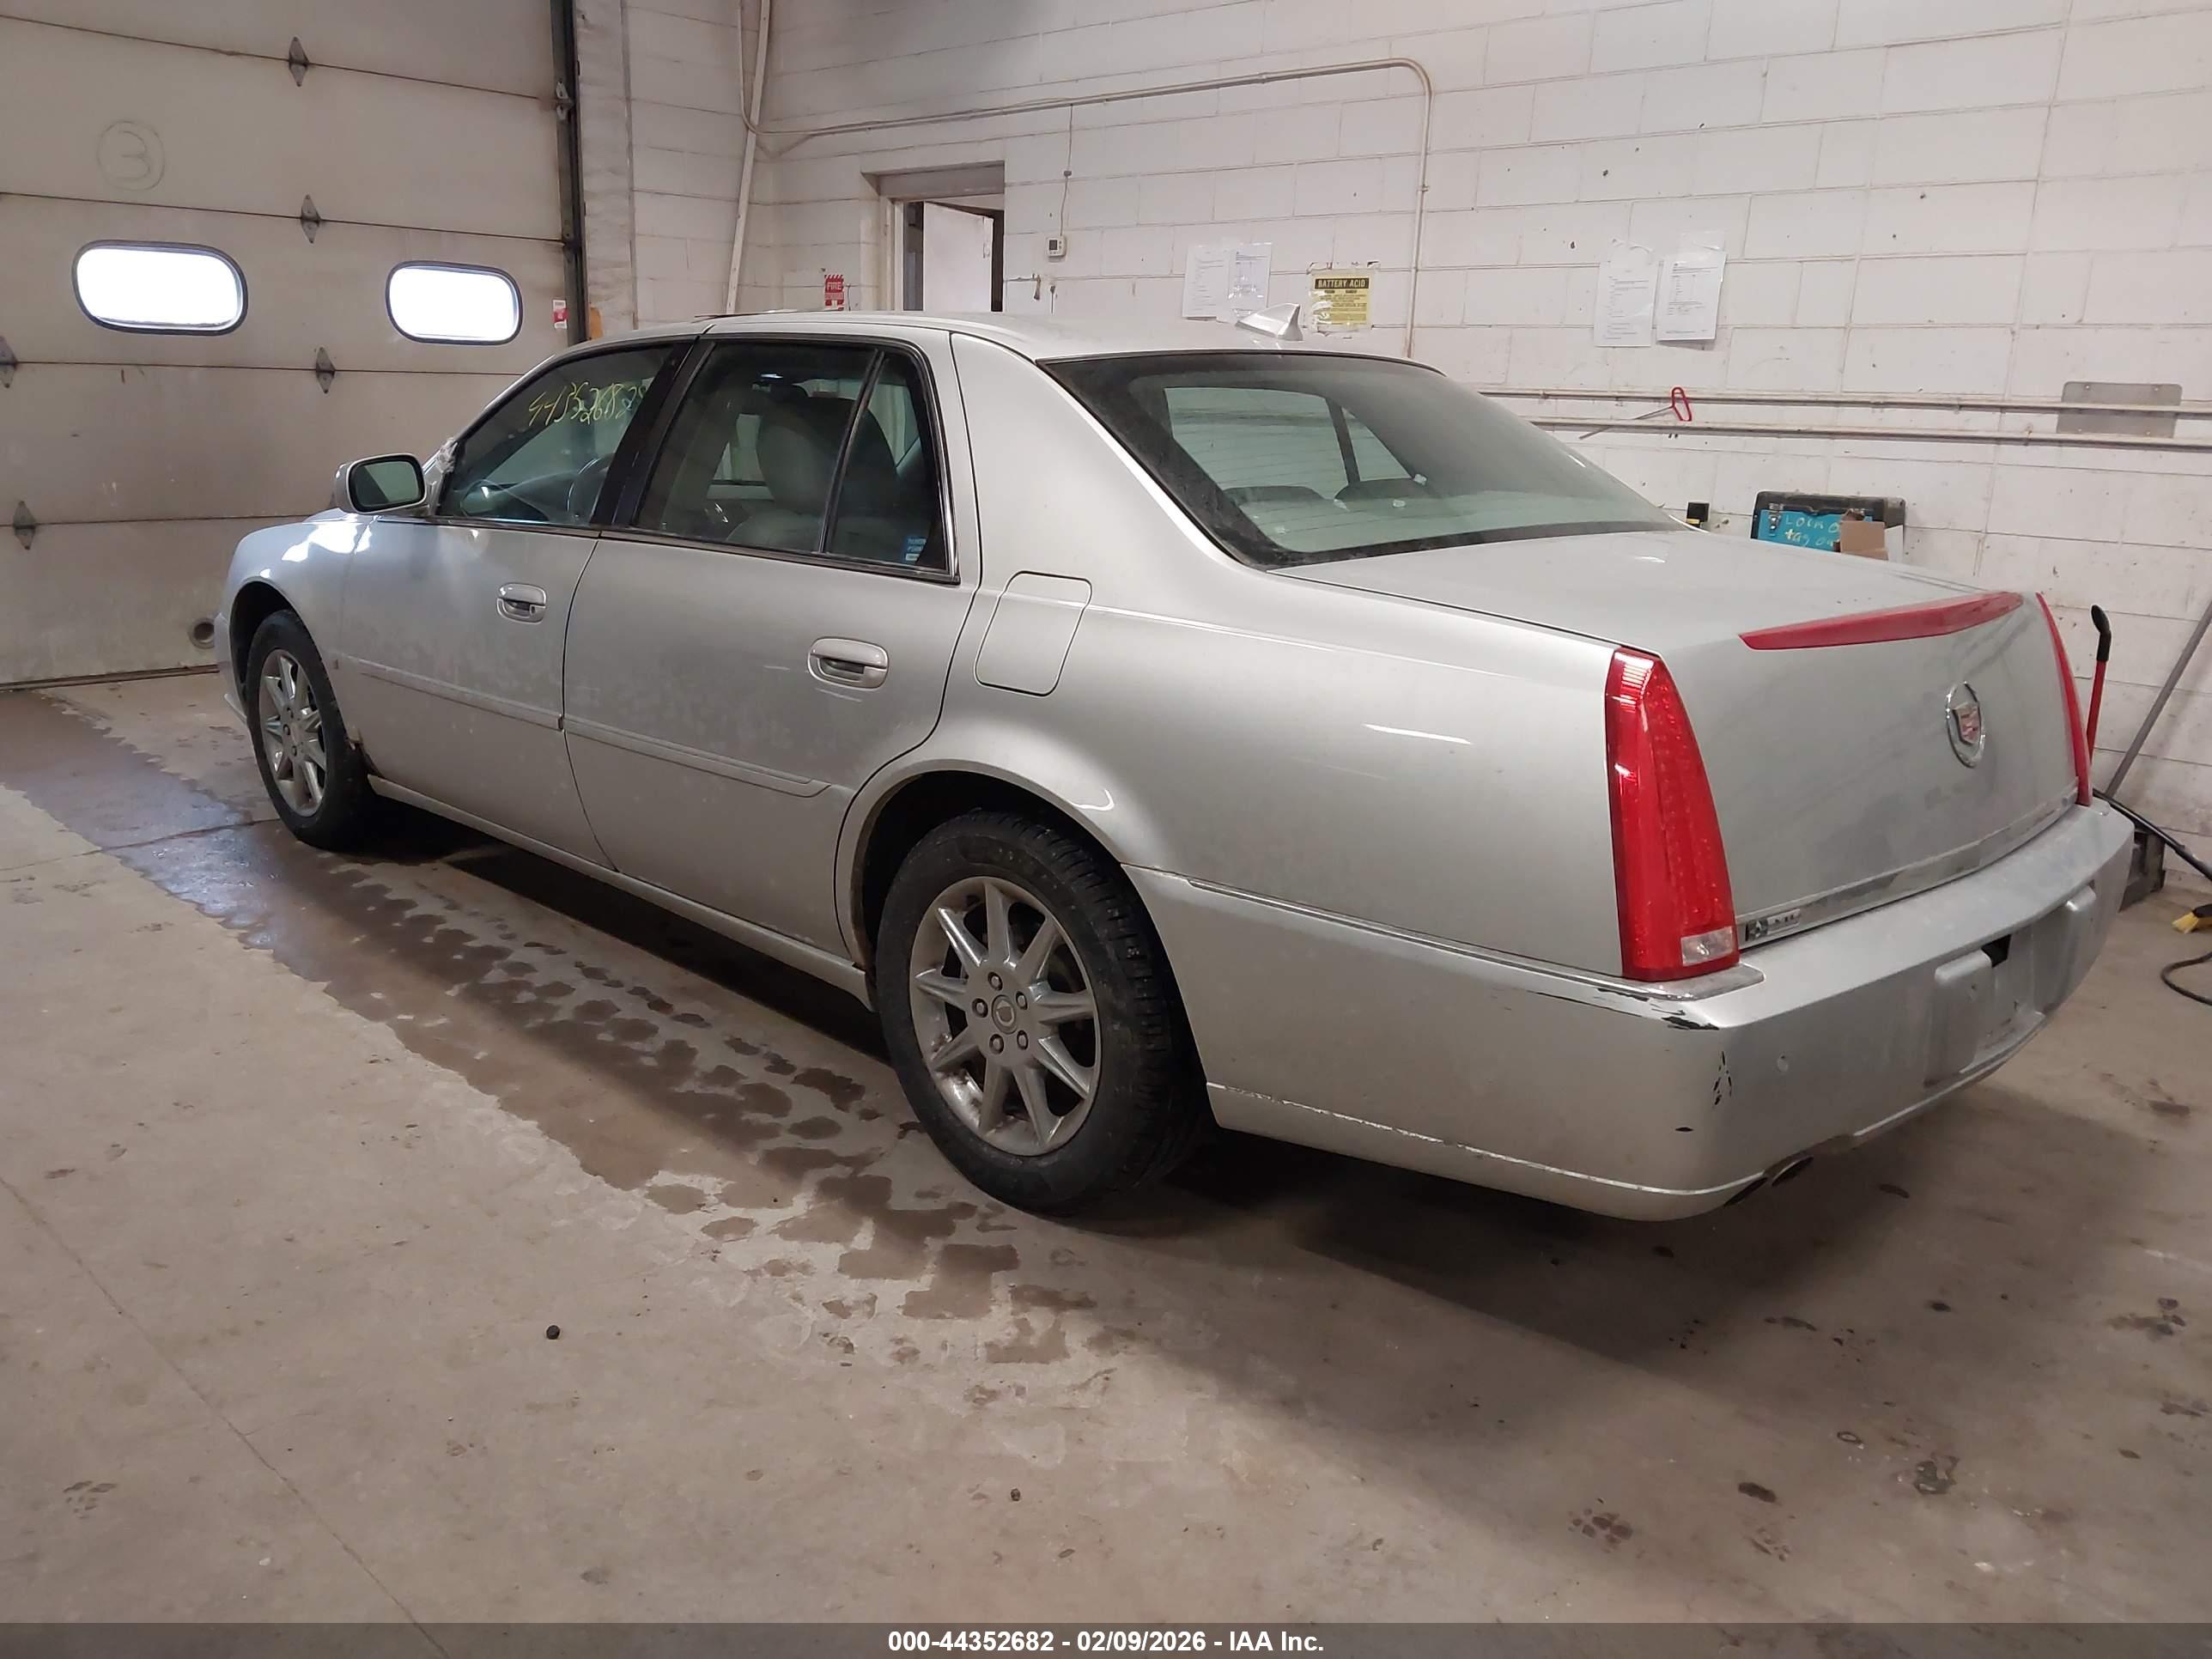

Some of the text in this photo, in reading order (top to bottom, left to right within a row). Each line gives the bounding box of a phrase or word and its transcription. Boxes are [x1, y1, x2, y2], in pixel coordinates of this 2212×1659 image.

[118, 129, 151, 180] 3
[1317, 279, 1366, 289] BATTERY ACID
